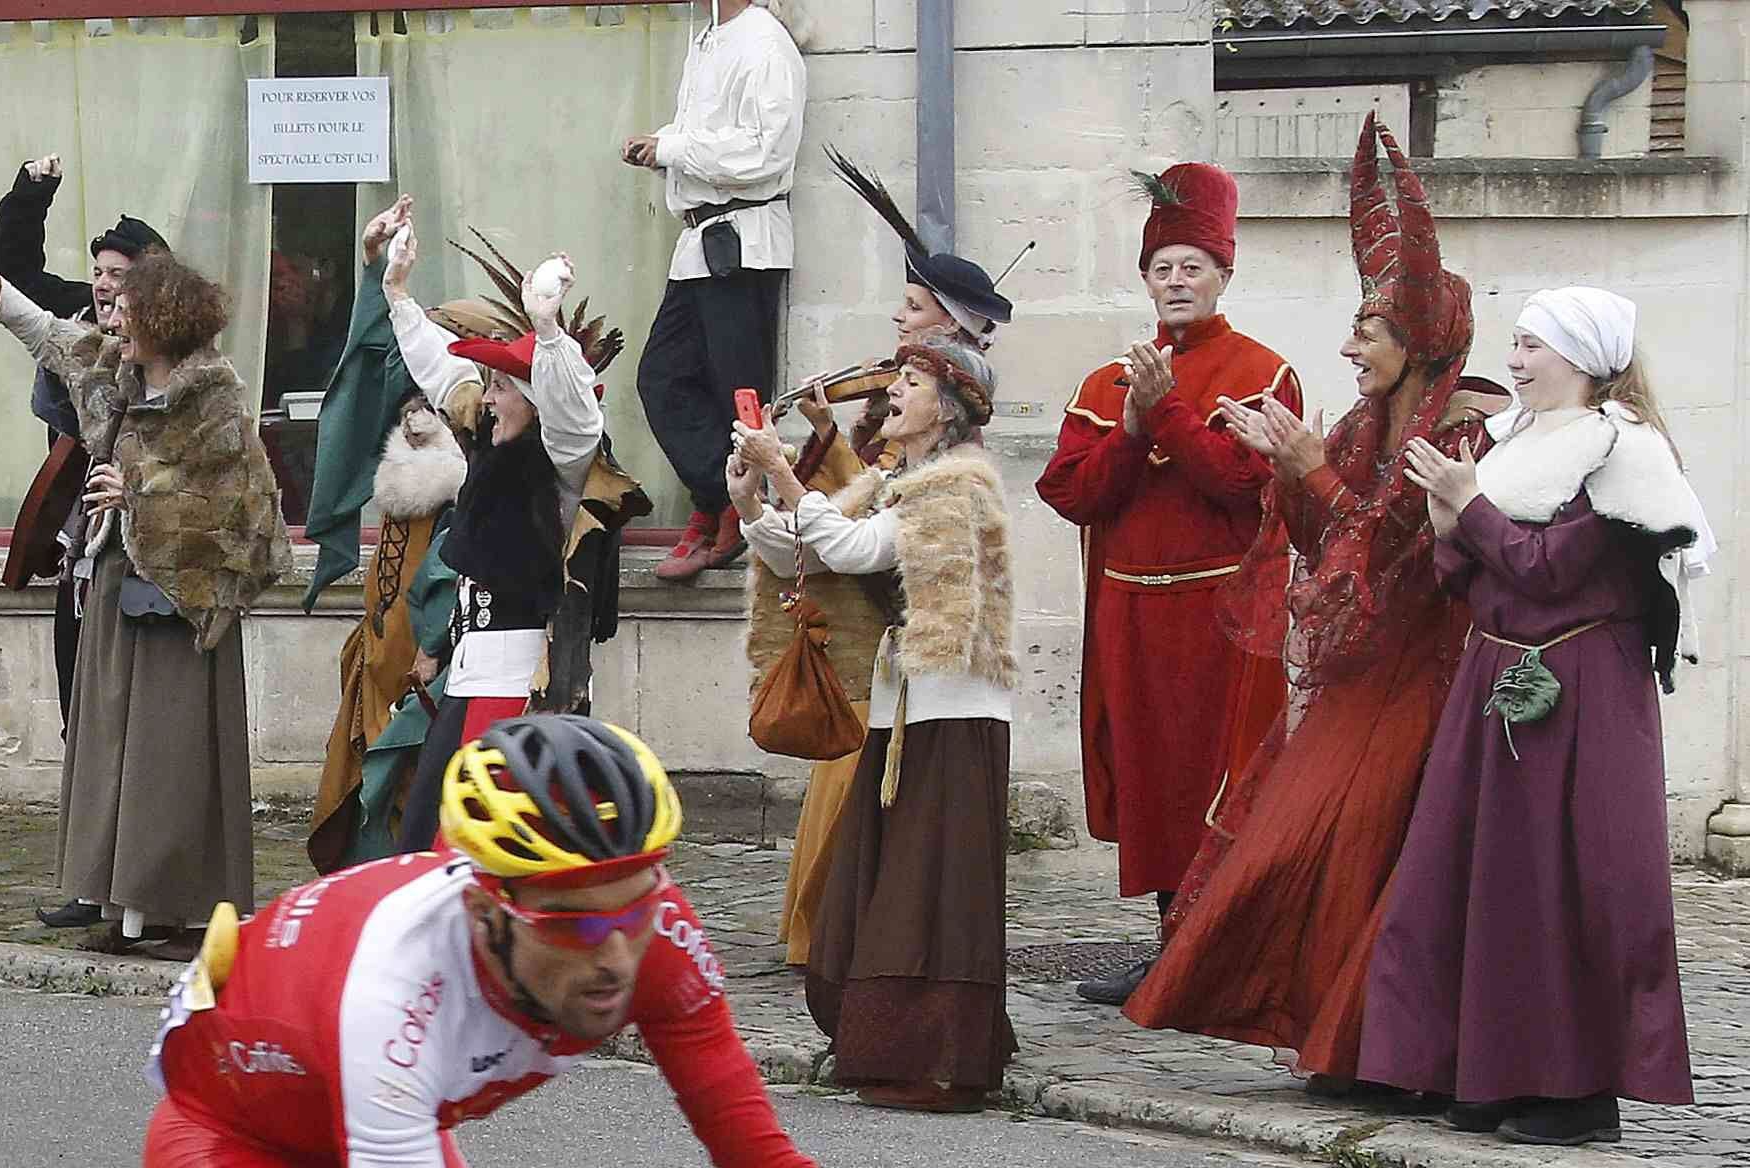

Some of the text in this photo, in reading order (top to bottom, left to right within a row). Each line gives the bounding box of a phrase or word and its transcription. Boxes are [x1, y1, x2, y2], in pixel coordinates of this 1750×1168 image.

[262, 91, 377, 103] POUR RESERVER VOS
[273, 122, 364, 133] BILLETS POUR LE
